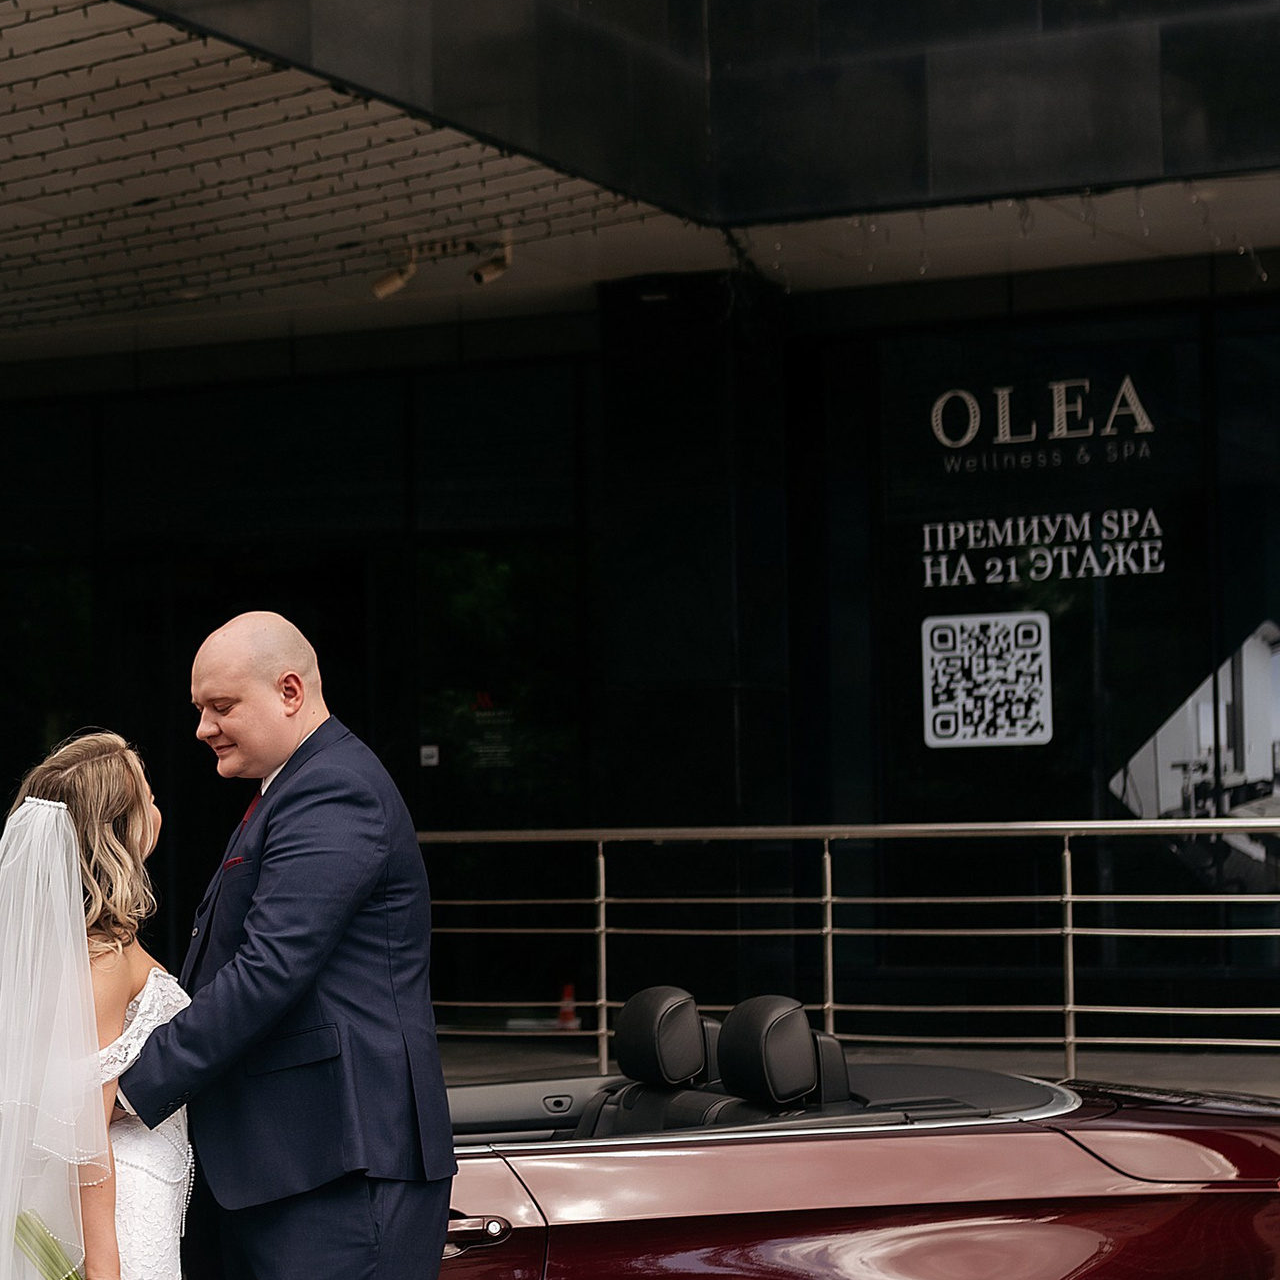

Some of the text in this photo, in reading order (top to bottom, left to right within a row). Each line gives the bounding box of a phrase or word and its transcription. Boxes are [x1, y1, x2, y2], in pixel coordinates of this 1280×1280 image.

[931, 374, 1155, 449] OLEA
[943, 439, 1151, 473] Wellness & SPA
[922, 508, 1163, 553] ПРЕМИУМ SPA
[923, 540, 1165, 588] НА 21 ЭТАЖЕ
